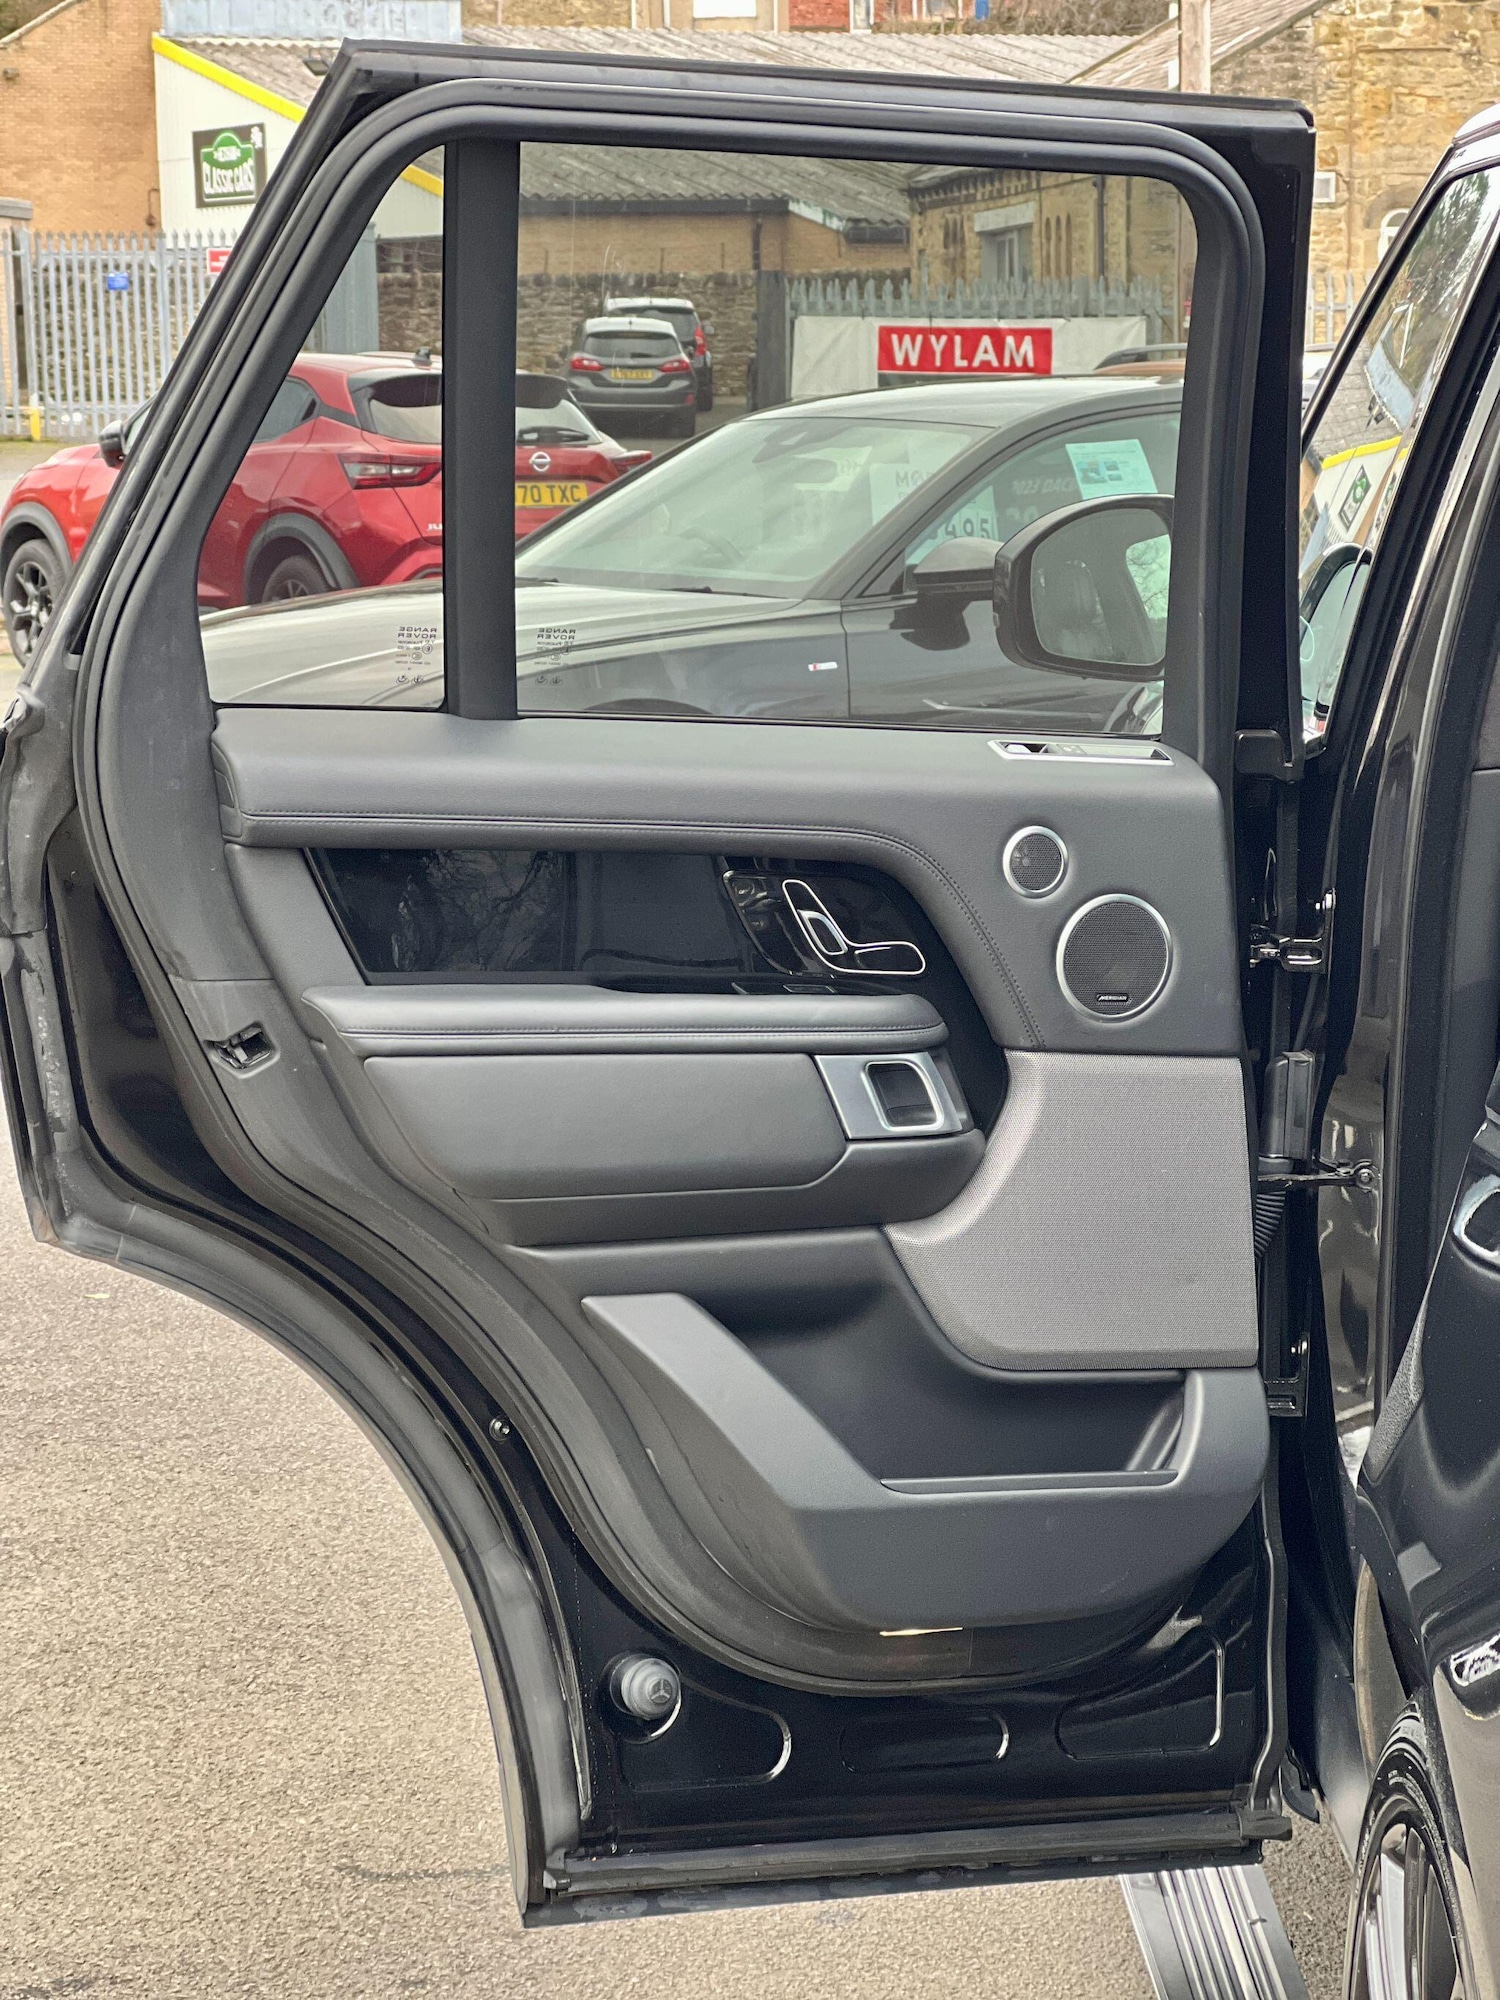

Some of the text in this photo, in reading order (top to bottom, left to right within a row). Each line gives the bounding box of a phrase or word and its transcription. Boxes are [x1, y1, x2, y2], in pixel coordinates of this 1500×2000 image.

[202, 157, 255, 195] CLASSIC CARS
[890, 333, 1035, 368] WYLAM
[517, 484, 582, 504] 70 TXC
